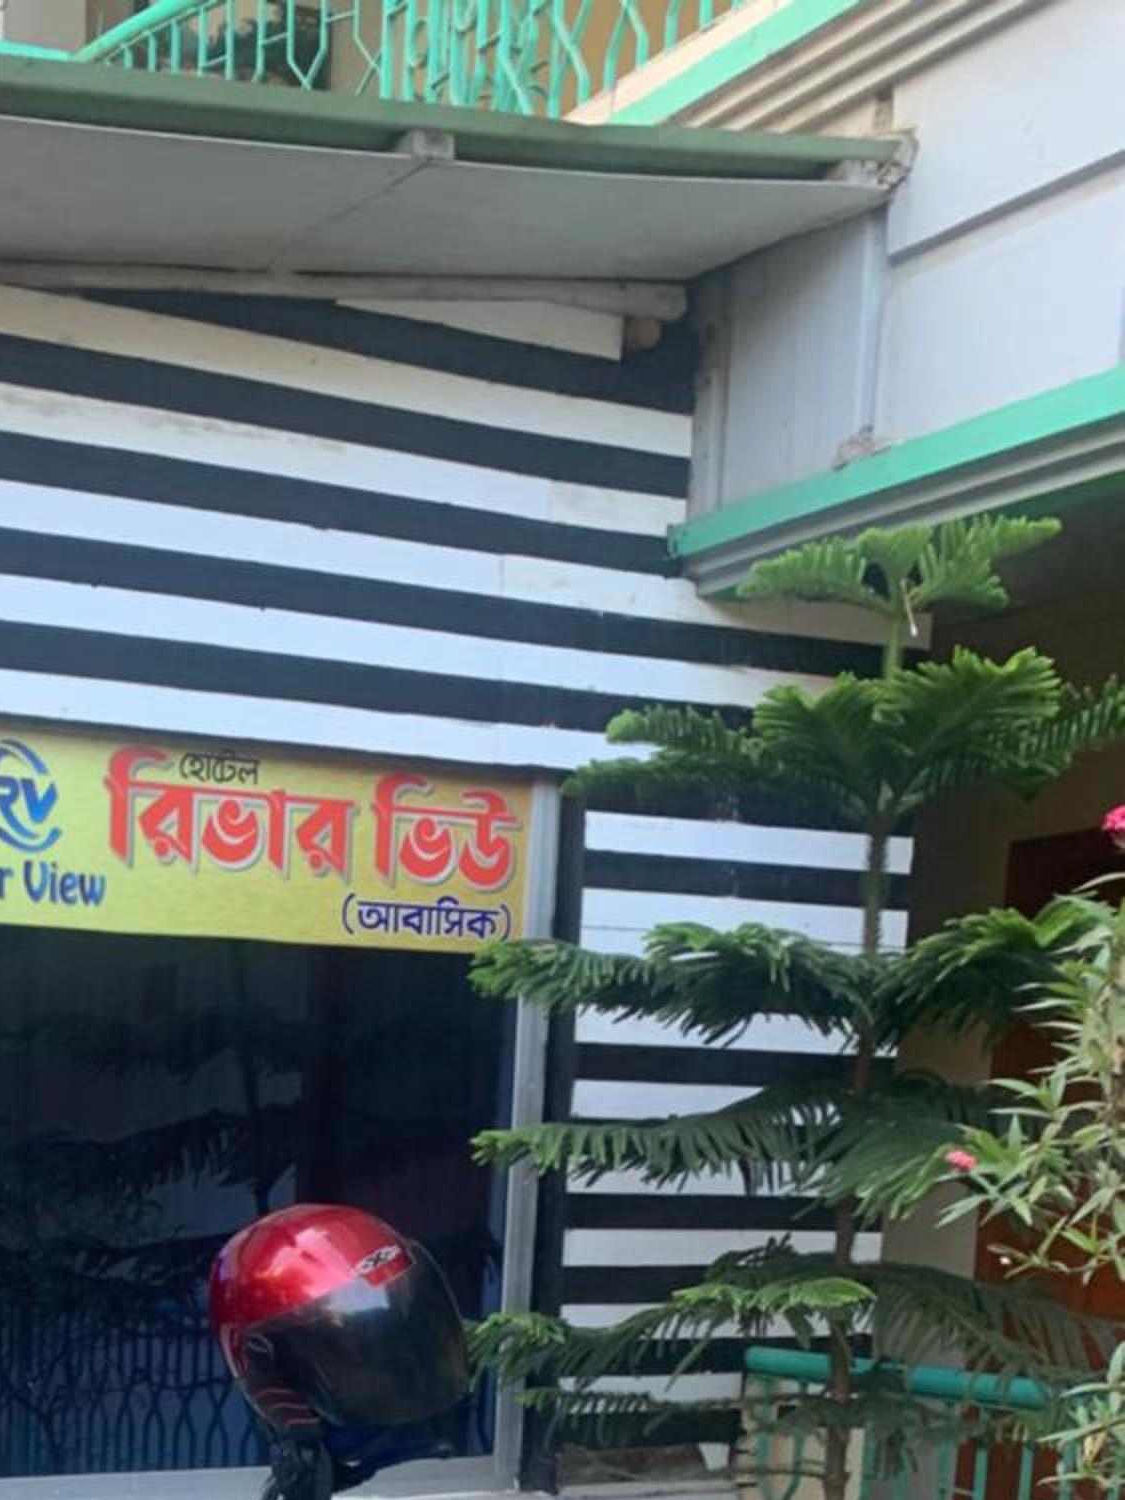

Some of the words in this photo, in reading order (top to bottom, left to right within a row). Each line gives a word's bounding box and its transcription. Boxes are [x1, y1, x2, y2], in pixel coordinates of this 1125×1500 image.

[178, 748, 261, 786] হোটেল
[104, 747, 357, 881] রিভার
[371, 772, 523, 894] ভিউ
[23, 858, 106, 907] View
[342, 892, 512, 940] (আবাসিক)
